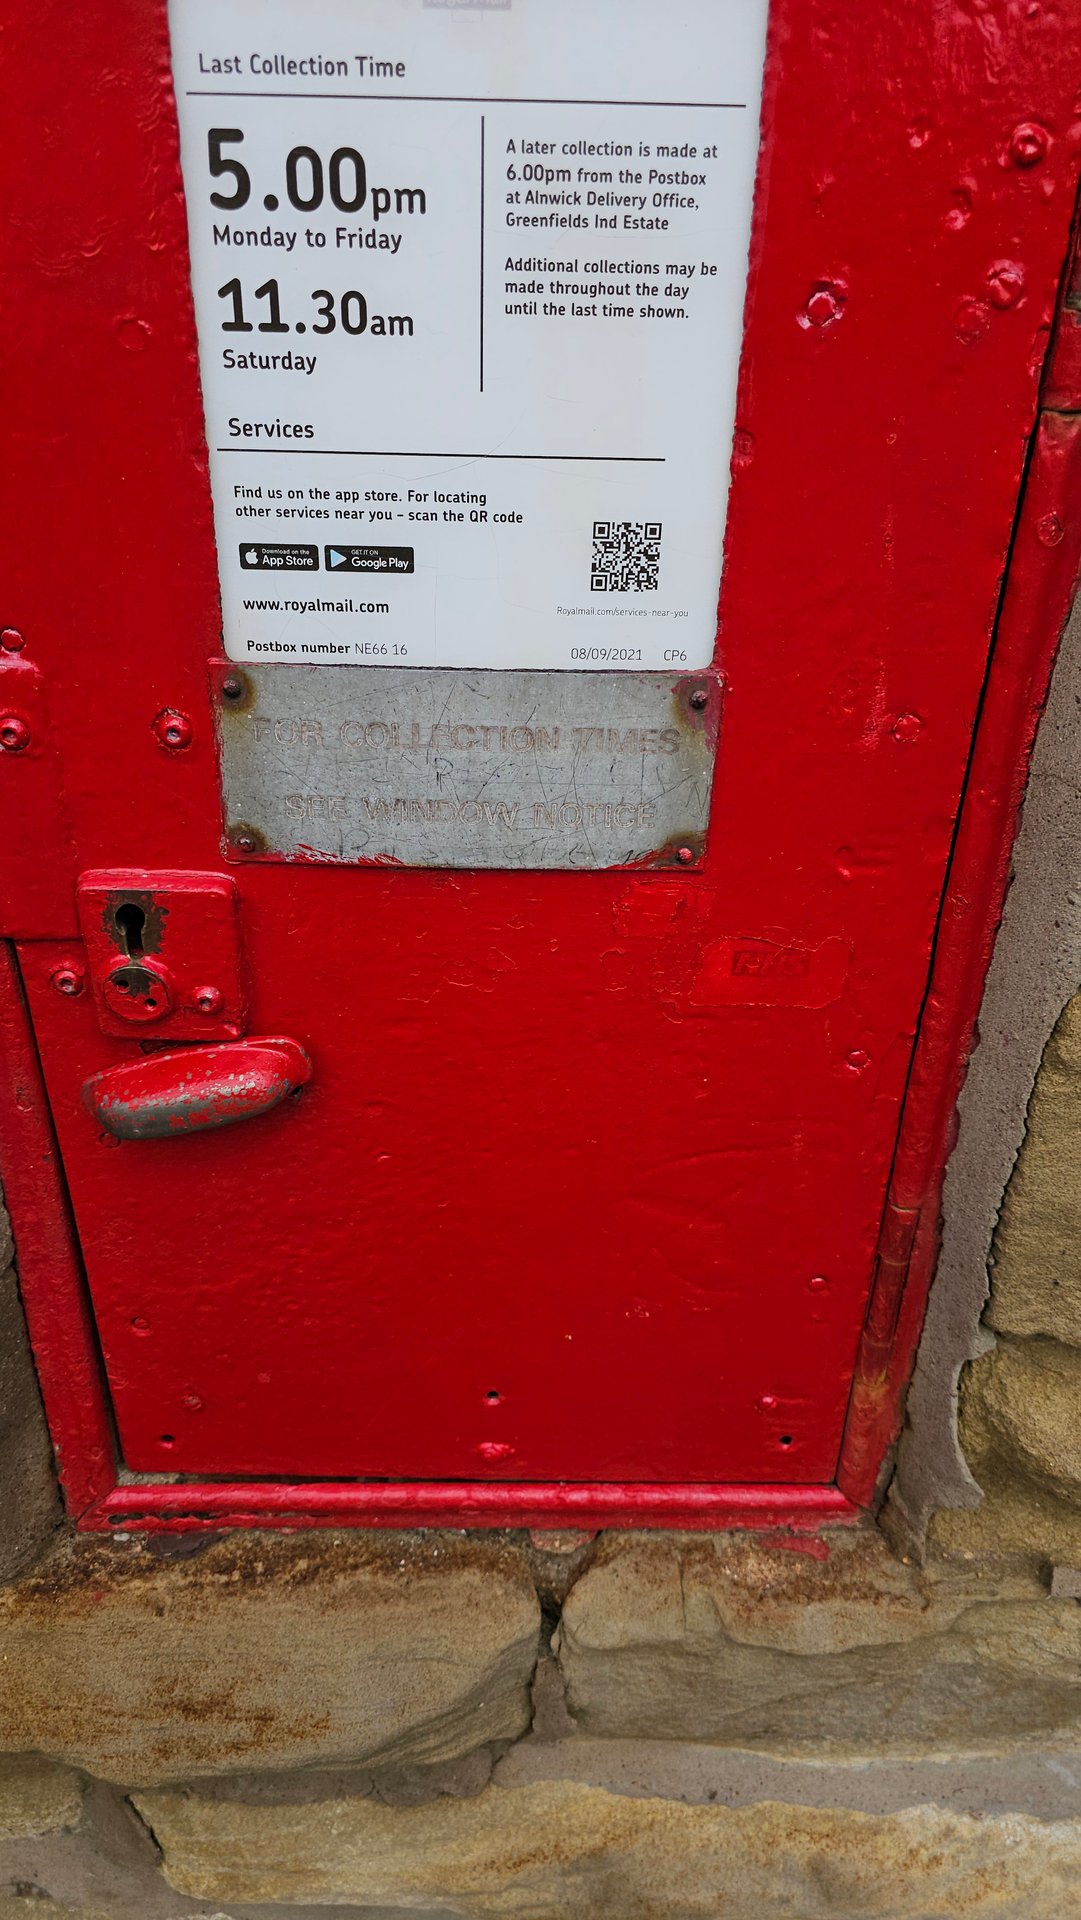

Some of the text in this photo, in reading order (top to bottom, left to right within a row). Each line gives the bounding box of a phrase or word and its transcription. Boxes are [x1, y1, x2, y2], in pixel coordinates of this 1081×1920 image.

[198, 52, 406, 78] Last Collection Time
[506, 138, 718, 159] A later collection is made at
[207, 127, 427, 222] 5.00pm
[506, 163, 707, 186] 6.00pm from the Postbox
[505, 189, 699, 211] at Alnwick Delivery Office,
[506, 211, 669, 231] Greenfields Ind Estate
[212, 224, 403, 255] Monday to Friday
[504, 256, 718, 279] Additional collections may be
[504, 279, 690, 301] made throughout the day
[217, 277, 414, 337] 11.30am
[504, 300, 689, 319] until the last time shown.
[222, 348, 317, 376] Saturday
[228, 417, 315, 439] Services
[233, 485, 487, 507] Find us on the app store. For locating
[235, 504, 272, 518] other
[275, 505, 330, 519] services
[334, 509, 365, 520] near
[368, 510, 393, 523] you
[408, 511, 438, 522] scan
[442, 509, 465, 522] the
[469, 509, 488, 523] QR
[492, 510, 523, 524] code
[263, 555, 313, 566] App Store
[352, 557, 408, 570] Google Play
[242, 598, 389, 615] www.royalmail.com
[556, 605, 689, 619] Royalmail.com/services-near-you
[246, 639, 408, 656] Postbox number NE66 16
[570, 647, 643, 661] 08/09/2021
[663, 649, 688, 662] CP6
[251, 717, 682, 756] FOR COLLECTION TIMES
[284, 795, 657, 830] SEE WINDOW NOTICE
